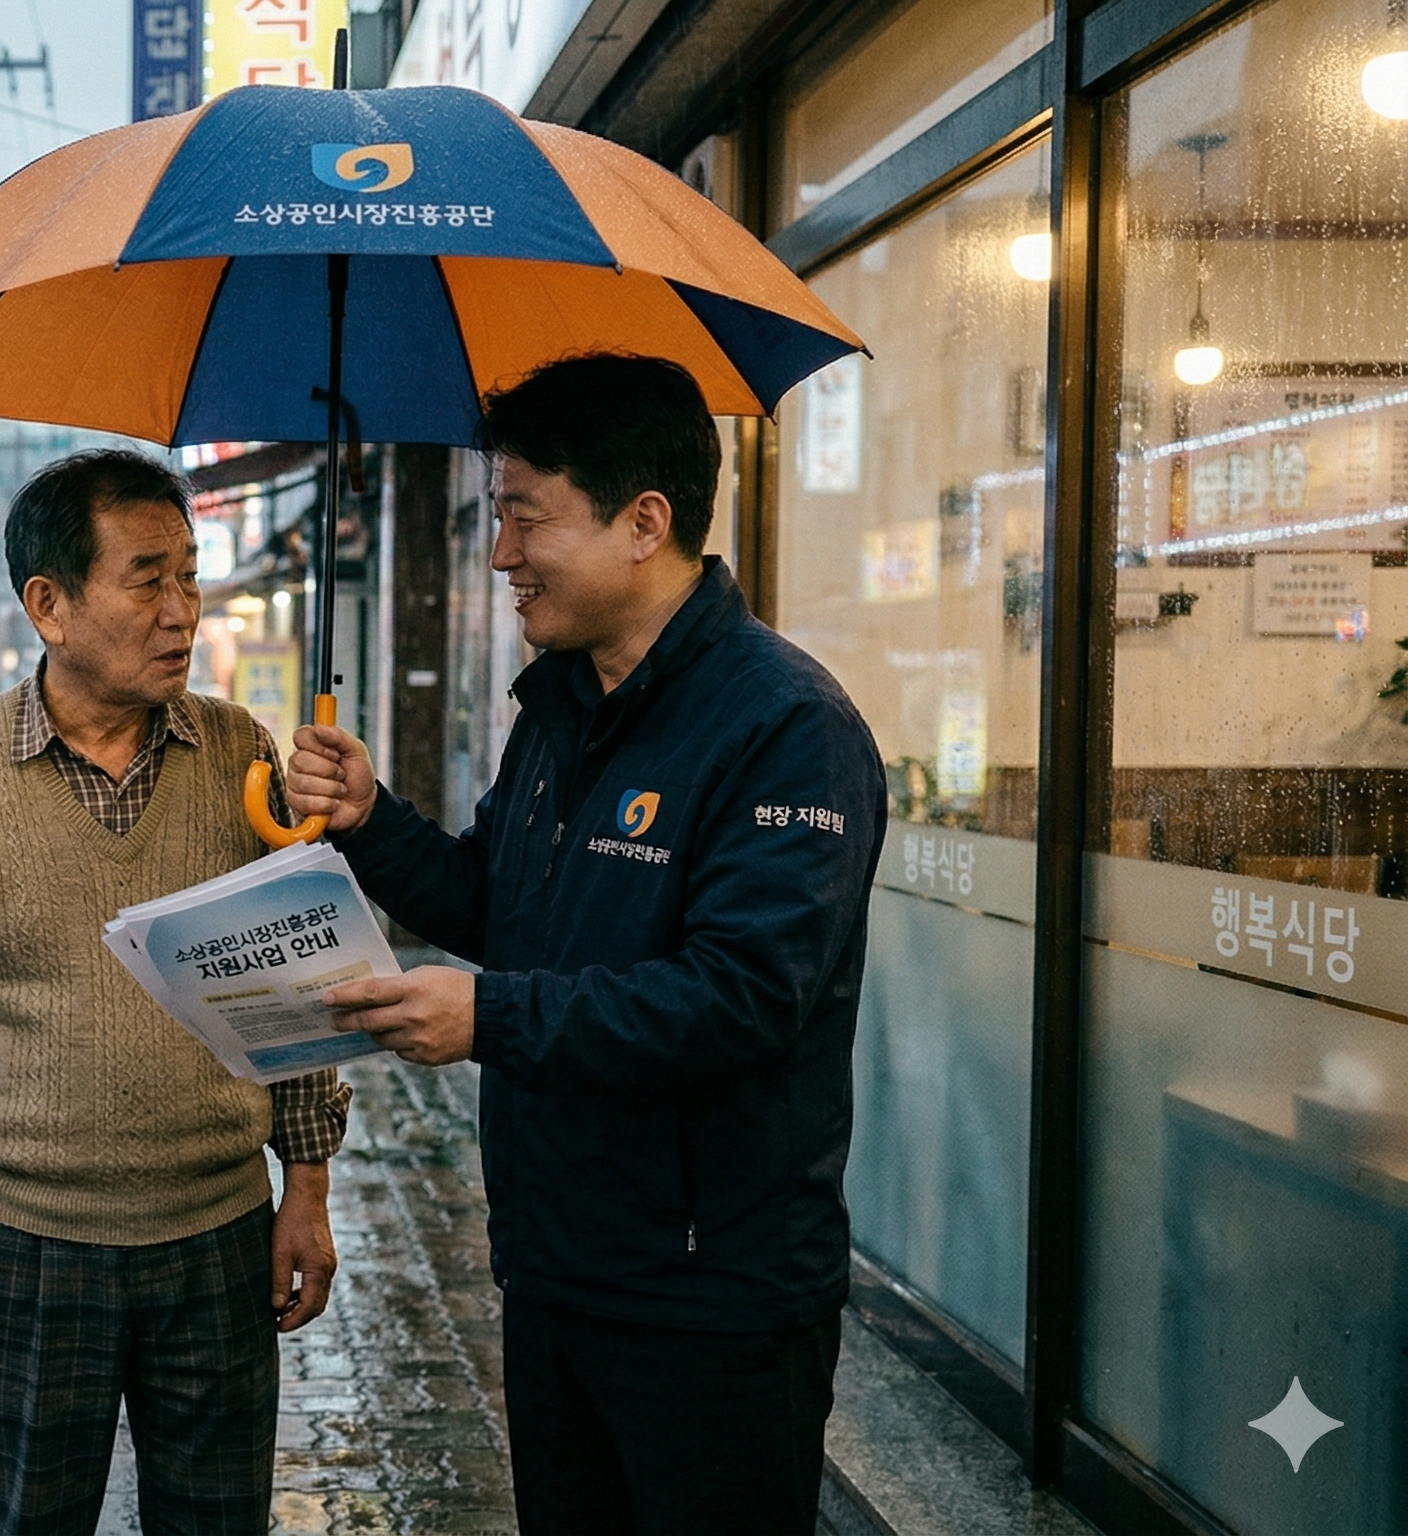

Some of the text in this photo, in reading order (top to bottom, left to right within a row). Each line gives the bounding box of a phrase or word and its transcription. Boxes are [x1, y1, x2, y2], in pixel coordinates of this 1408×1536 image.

[234, 202, 495, 228] 소상공인시장진흥공단
[754, 804, 793, 828] 현장
[174, 901, 340, 964] 소상공인시장진흥공단
[195, 925, 341, 980] 지원사업 안내
[1210, 887, 1360, 983] 행복식당
